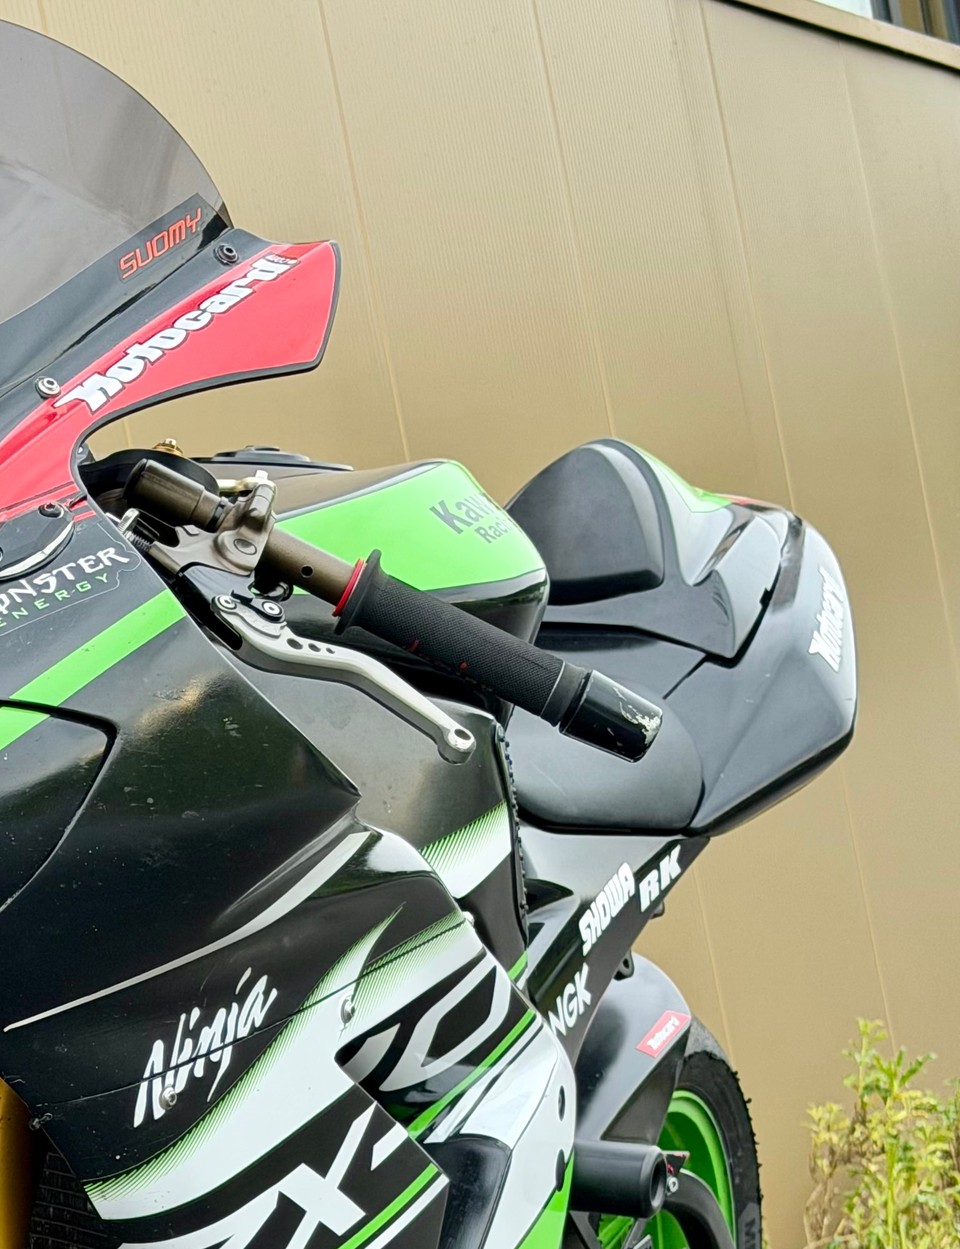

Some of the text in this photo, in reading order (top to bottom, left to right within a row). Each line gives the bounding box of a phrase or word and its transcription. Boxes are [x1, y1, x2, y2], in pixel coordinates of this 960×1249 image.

[119, 207, 202, 279] SUOMY
[578, 862, 635, 956] SHOWA
[639, 844, 682, 912] RK
[547, 962, 592, 1036] NGK
[133, 966, 278, 1129] Ninja
